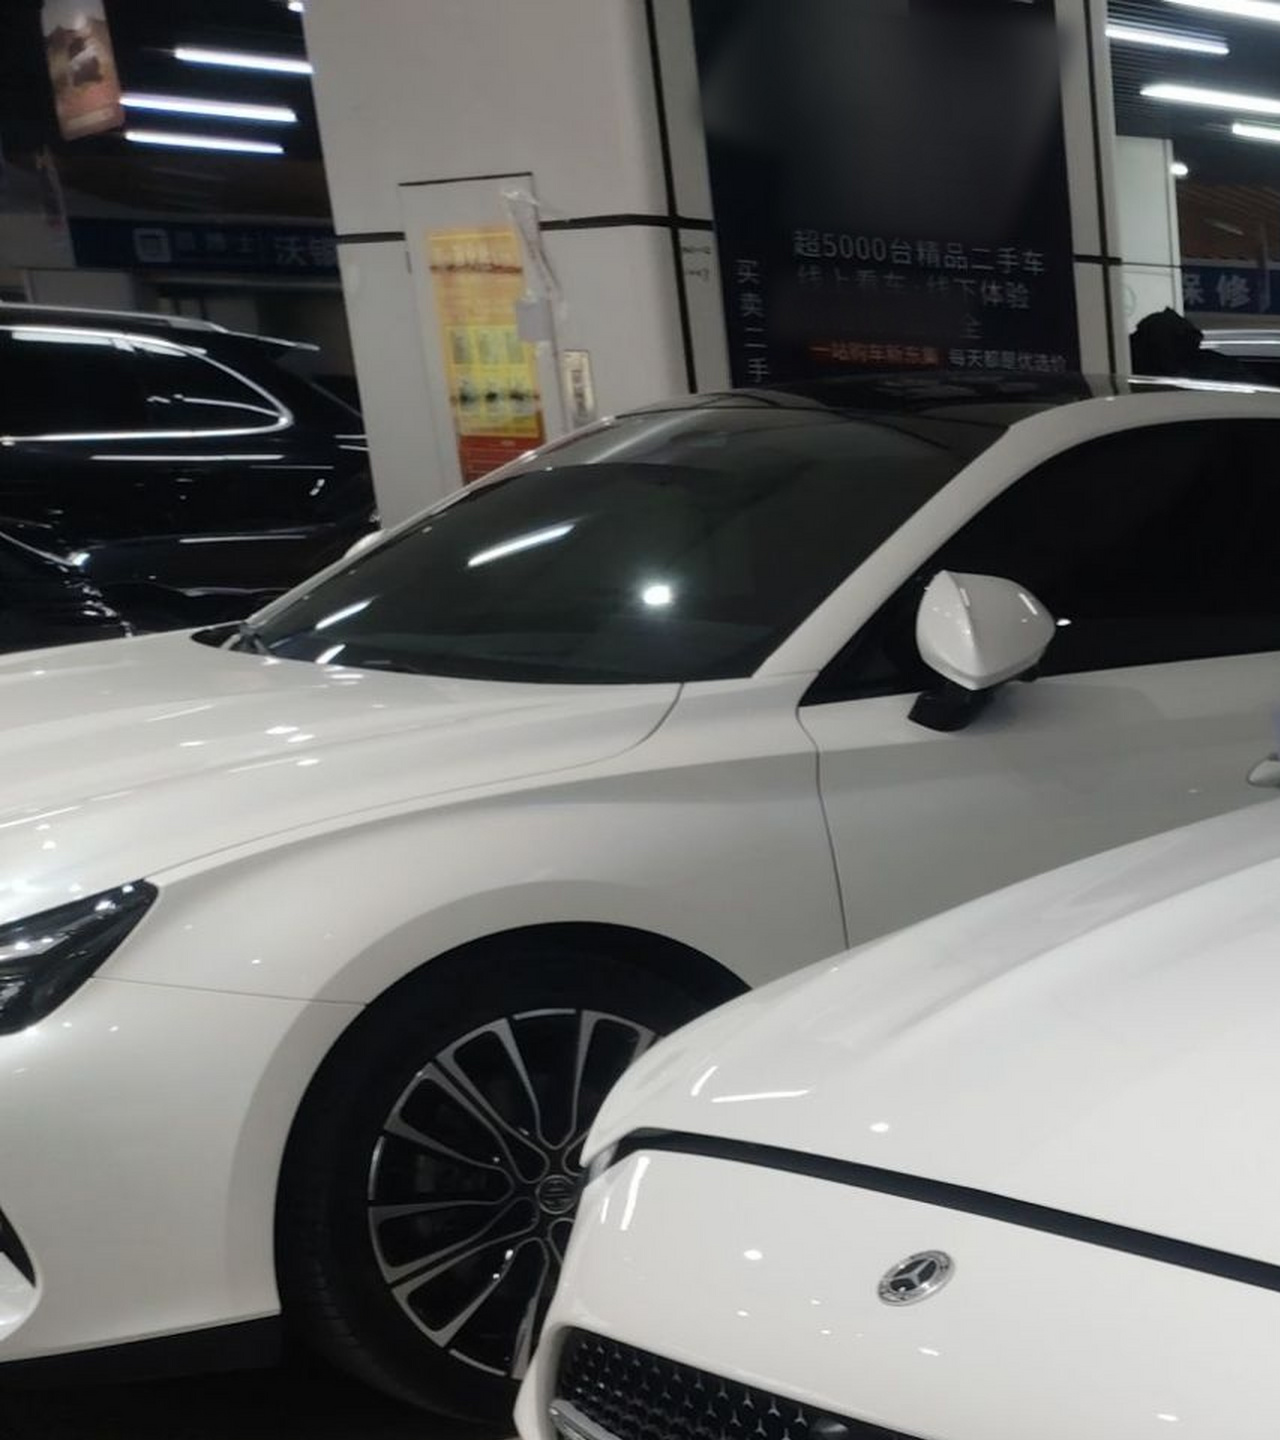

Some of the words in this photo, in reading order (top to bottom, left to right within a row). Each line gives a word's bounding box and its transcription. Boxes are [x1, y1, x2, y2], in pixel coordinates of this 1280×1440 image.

[793, 229, 1046, 276] 超5000台精品二手车
